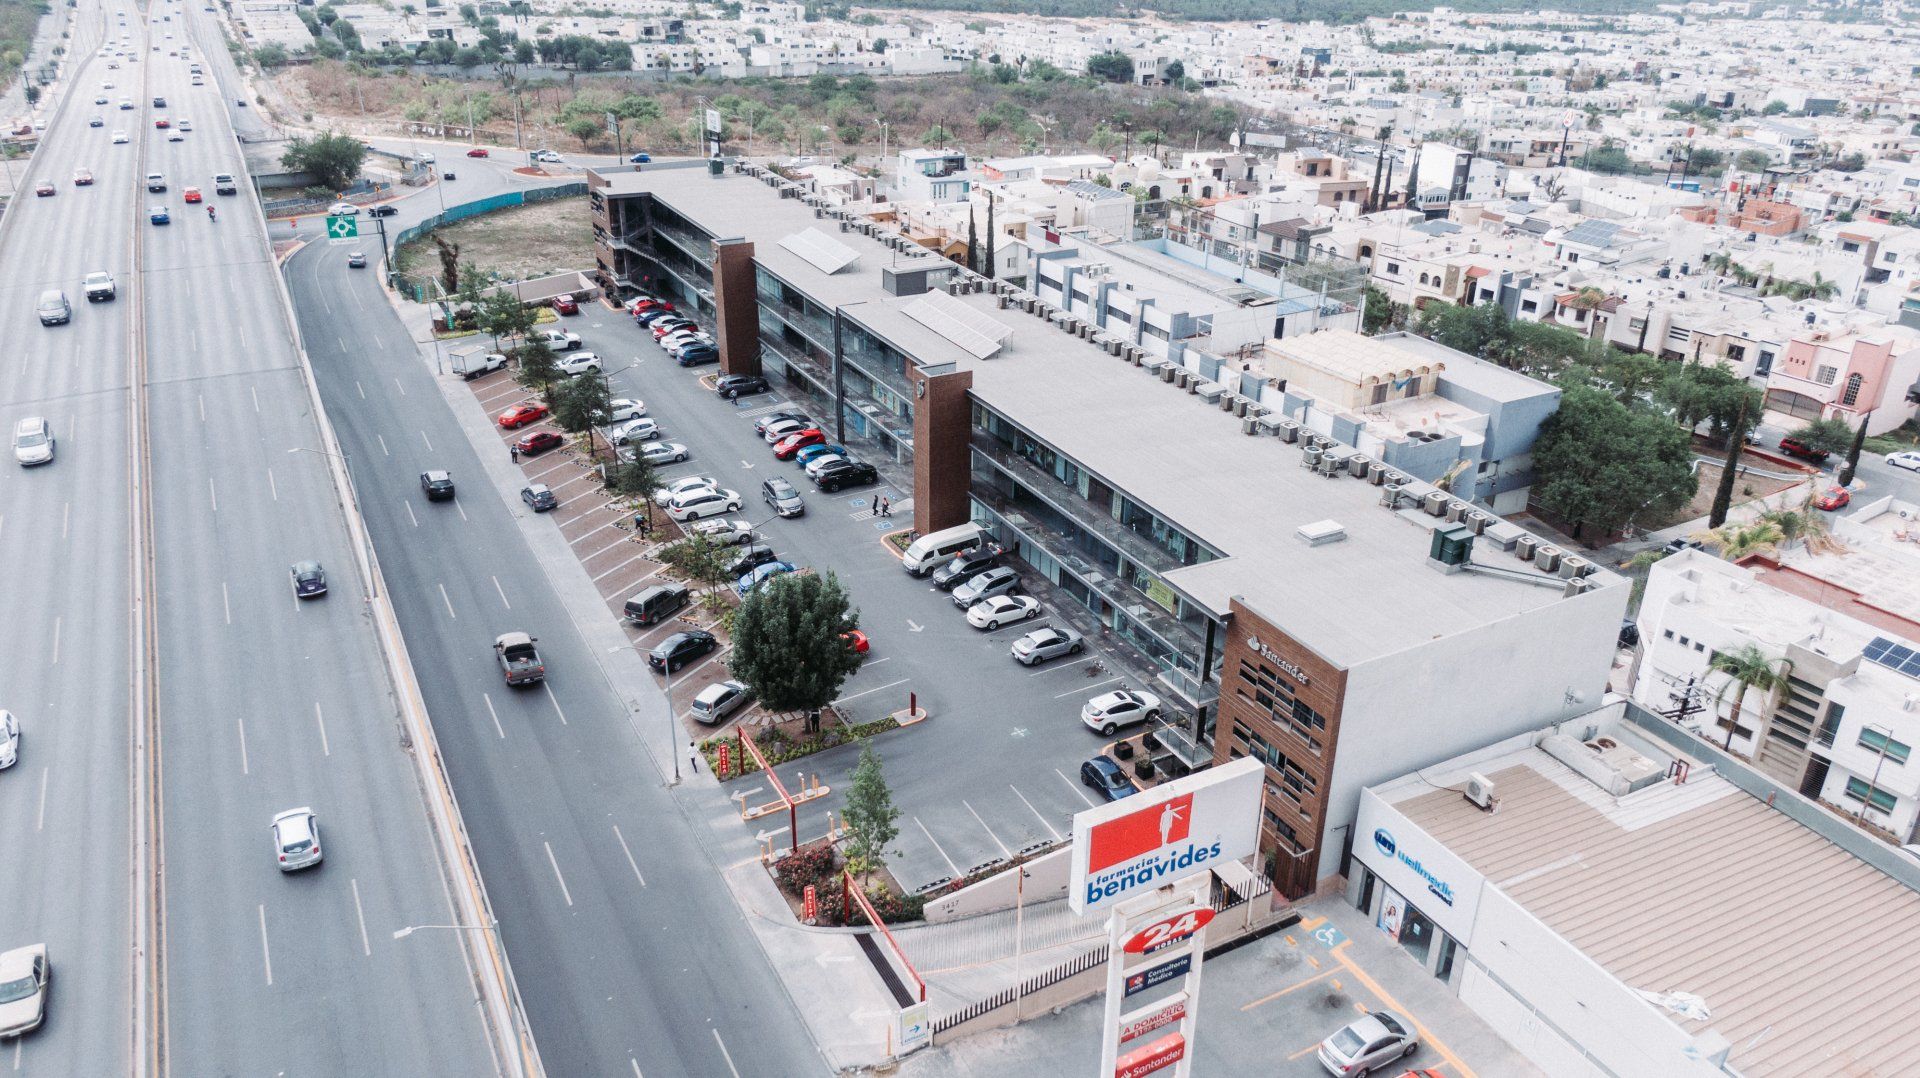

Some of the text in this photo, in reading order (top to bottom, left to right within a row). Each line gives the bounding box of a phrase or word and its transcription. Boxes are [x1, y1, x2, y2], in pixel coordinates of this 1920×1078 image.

[1261, 644, 1309, 685] Santander
[1087, 841, 1221, 905] benavides
[1097, 855, 1160, 885] farmacias
[1143, 911, 1199, 948] 24
[1154, 935, 1183, 951] HORAS
[1148, 959, 1188, 978] Consultorio
[1123, 1027, 1131, 1035] A
[1133, 1004, 1185, 1031] DOMICILIO
[1133, 1048, 1183, 1077] Santander
